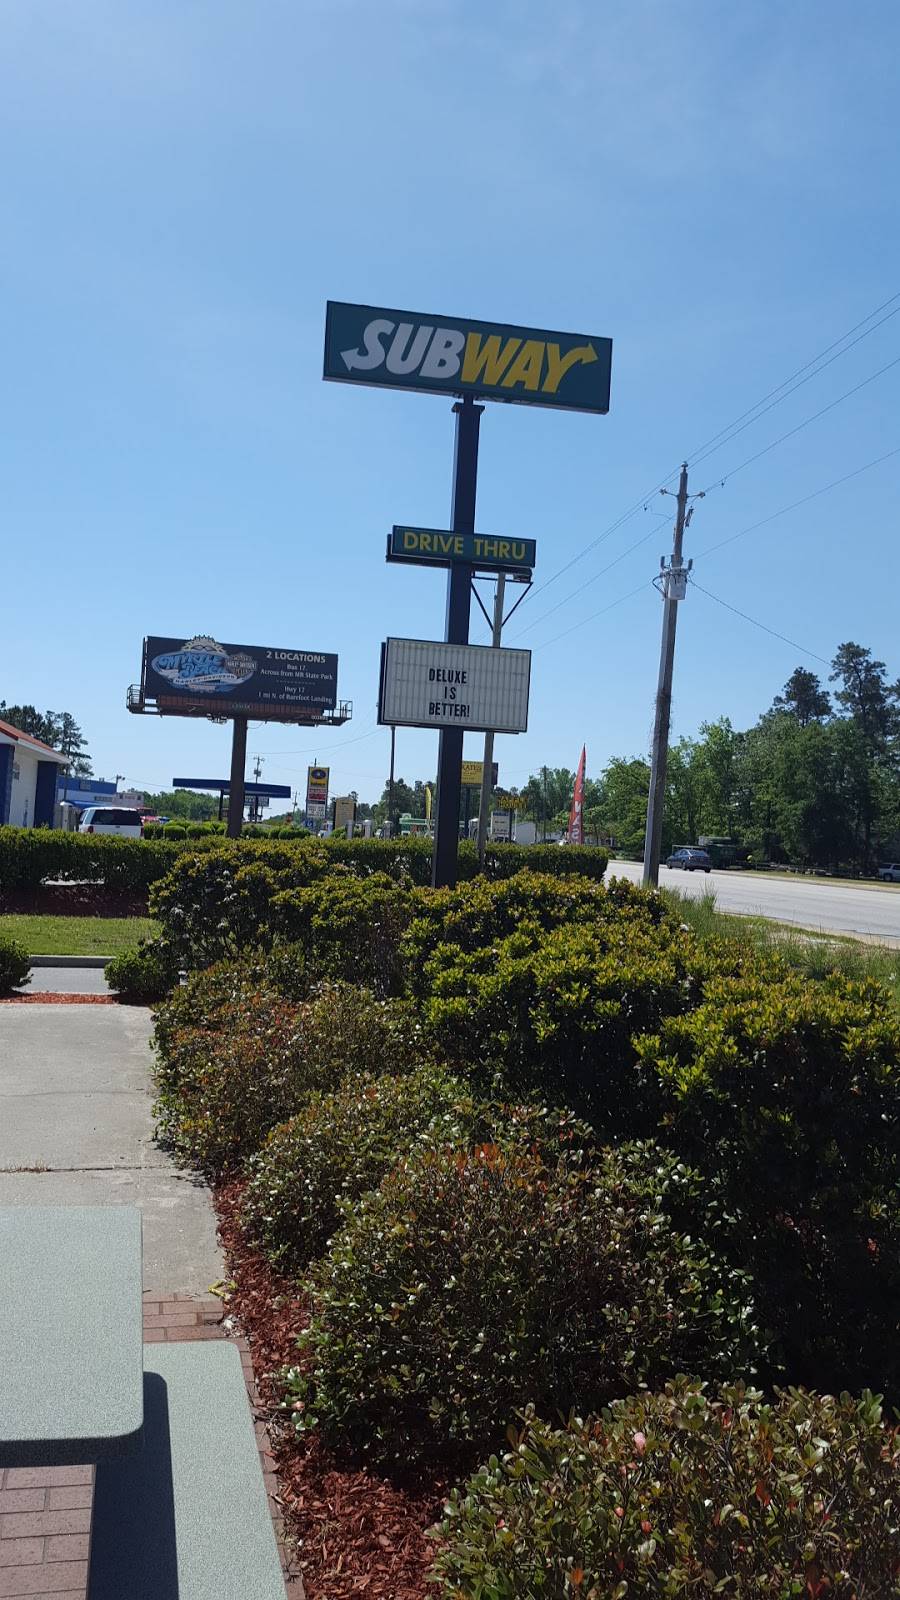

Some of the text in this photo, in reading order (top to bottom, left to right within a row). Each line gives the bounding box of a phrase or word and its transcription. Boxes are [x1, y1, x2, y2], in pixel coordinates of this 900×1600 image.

[340, 319, 599, 393] SUBWAY
[403, 531, 526, 560] DRIVE THRU
[266, 650, 326, 664] 2 LOCATIONS
[260, 668, 280, 676] Across
[280, 669, 294, 677] from
[305, 671, 320, 679] State
[428, 668, 468, 684] DELUXE
[310, 695, 333, 705] Landing
[444, 686, 457, 700] IS
[428, 702, 470, 718] BETTER!
